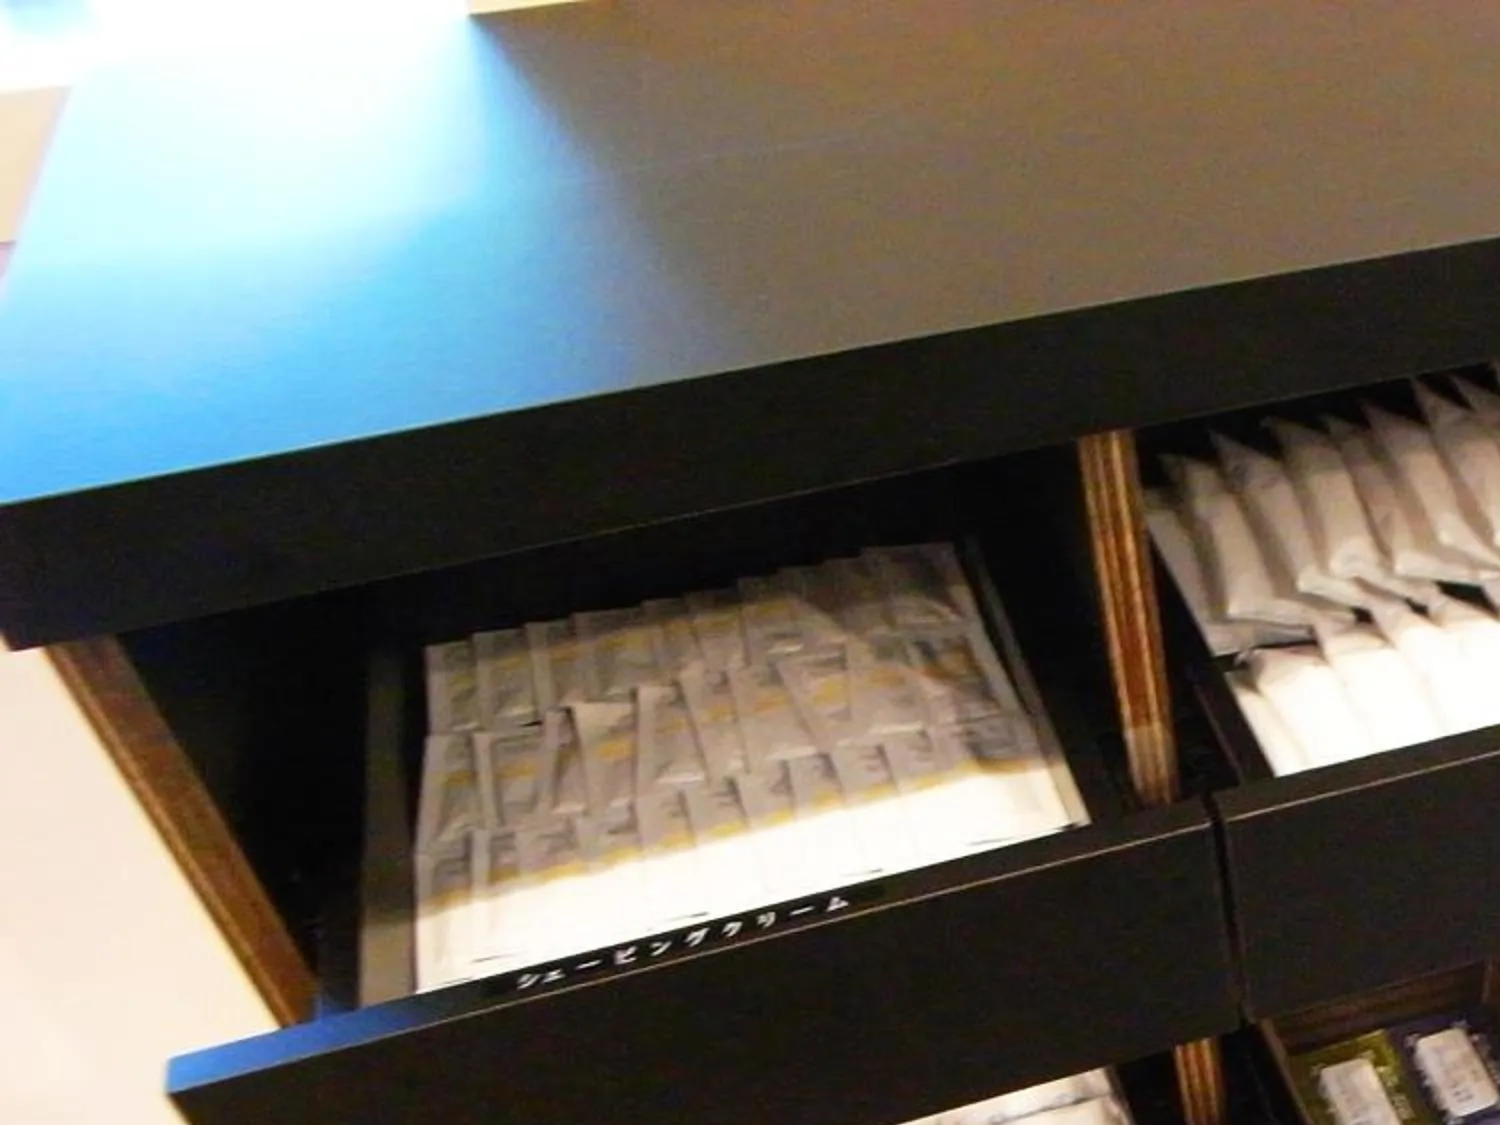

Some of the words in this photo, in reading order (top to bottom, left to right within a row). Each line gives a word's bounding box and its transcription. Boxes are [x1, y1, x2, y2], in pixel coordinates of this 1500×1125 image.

[515, 896, 850, 991] シェービングクリーム
